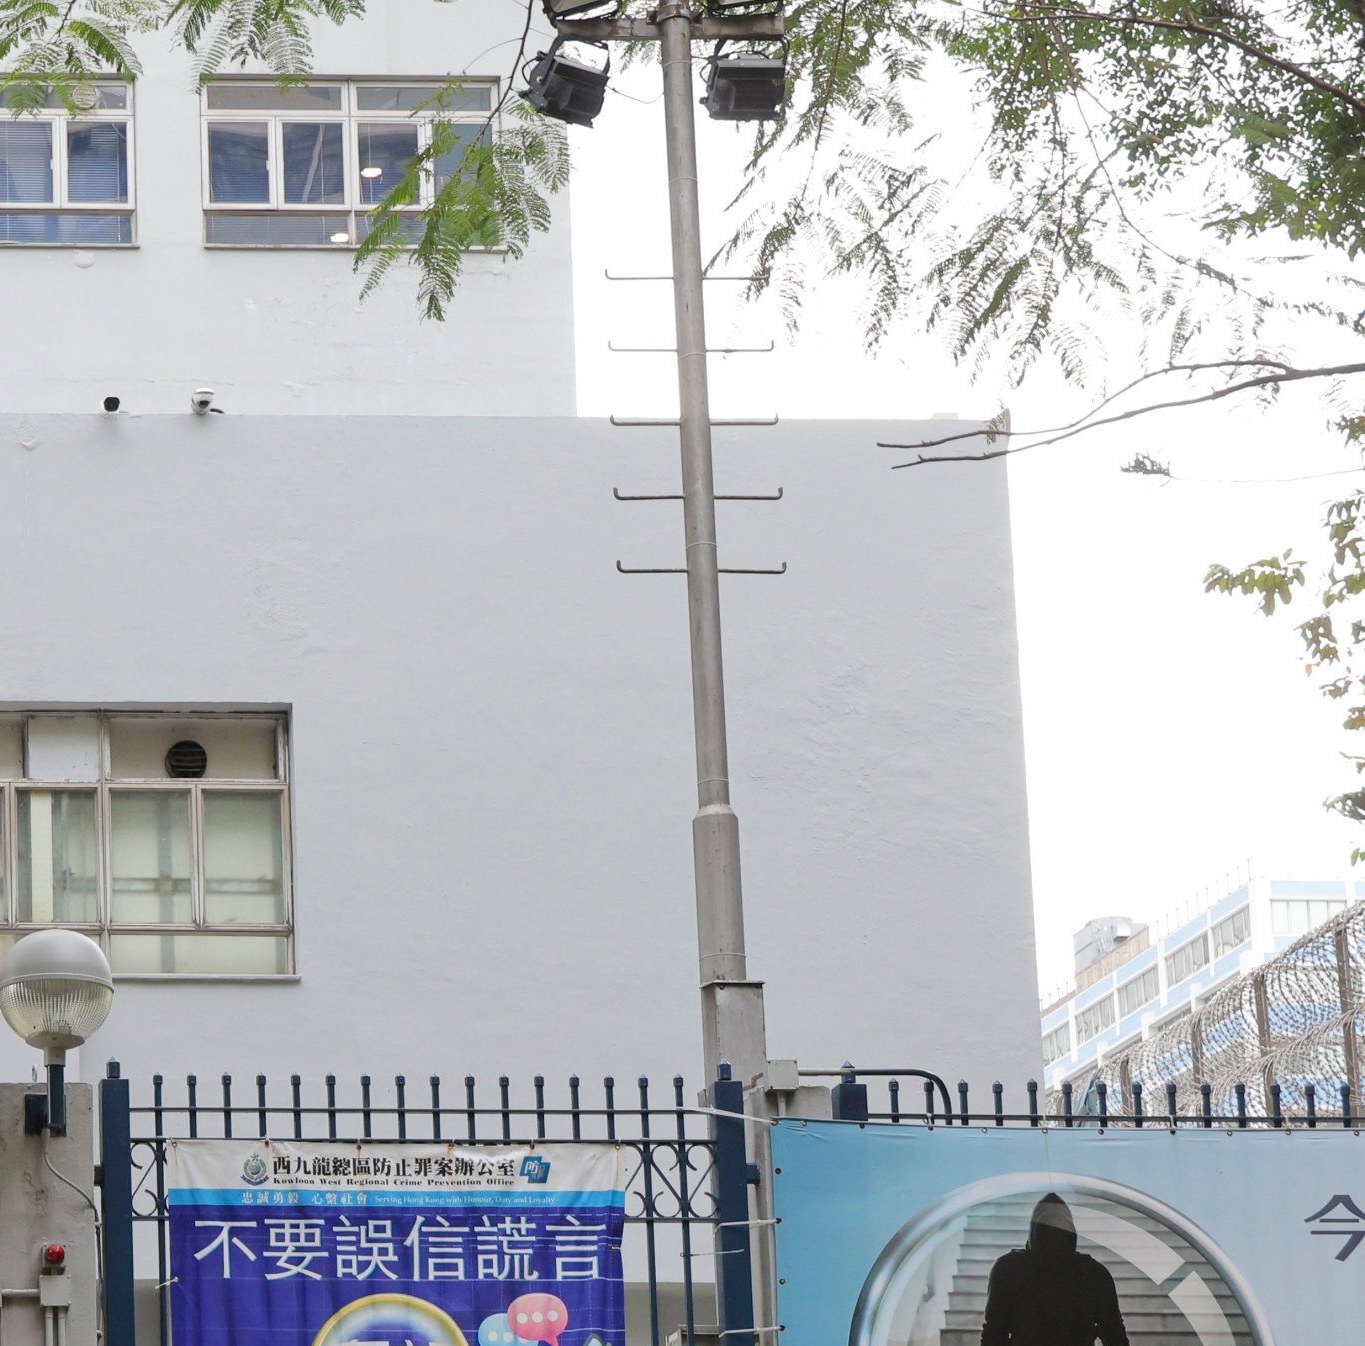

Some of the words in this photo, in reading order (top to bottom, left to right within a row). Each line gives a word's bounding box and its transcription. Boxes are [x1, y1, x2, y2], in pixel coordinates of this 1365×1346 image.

[272, 1155, 515, 1178] 西九龍總區防止罪案辦公室
[273, 1177, 315, 1186] Kowloon
[319, 1177, 341, 1186] West
[346, 1177, 389, 1187] Regional
[393, 1177, 423, 1186] Crime
[427, 1177, 482, 1186] Prevention
[486, 1177, 515, 1186] Office
[242, 1191, 300, 1206] 忠誠勇毅
[375, 1194, 402, 1206] Serving
[403, 1194, 423, 1206] Hong
[425, 1194, 445, 1206] Kong
[445, 1194, 463, 1206] with
[495, 1194, 512, 1206] Duty
[513, 1194, 528, 1206] and
[529, 1194, 555, 1206] Loyalty
[1304, 1195, 1365, 1262] 今
[193, 1214, 607, 1282] 不要誤信謊言
